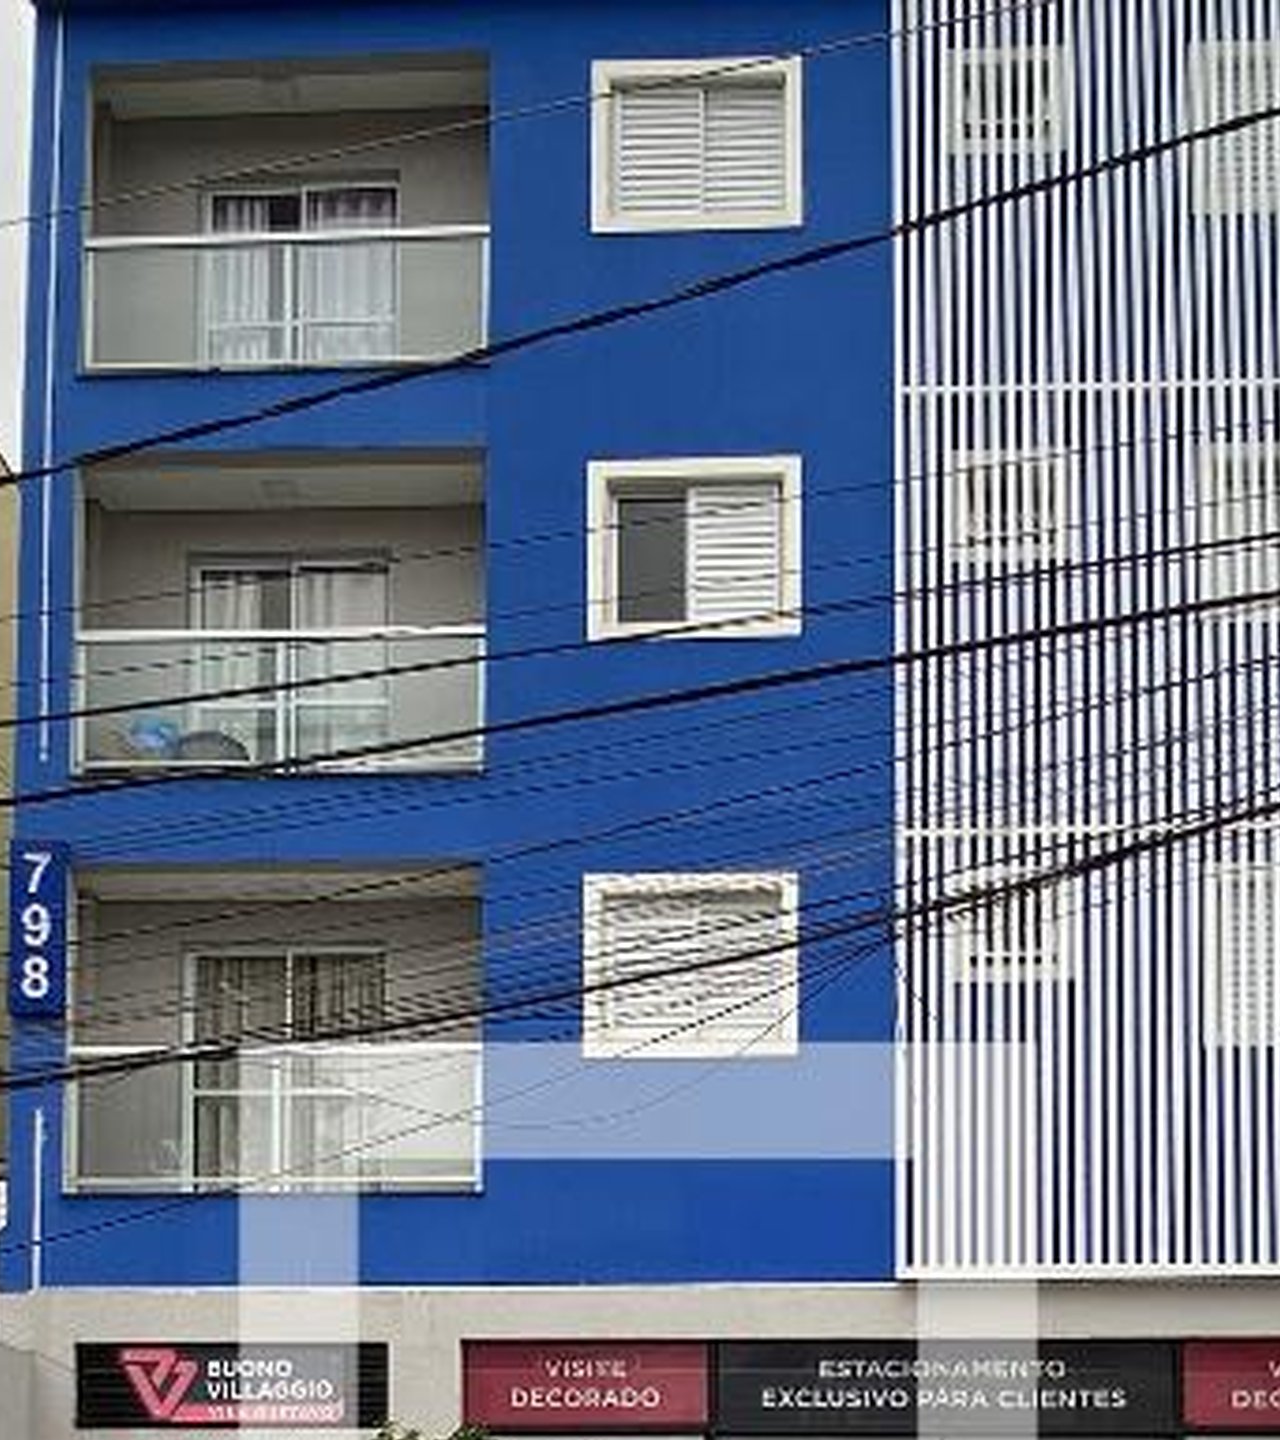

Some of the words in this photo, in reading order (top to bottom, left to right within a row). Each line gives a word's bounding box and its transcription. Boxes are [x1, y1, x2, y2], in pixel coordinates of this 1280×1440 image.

[22, 853, 51, 998] 798
[207, 1360, 293, 1377] BUONO
[545, 1359, 627, 1378] VISITE
[818, 1359, 1066, 1379] ESTACIONAMENTO
[207, 1379, 334, 1400] VILLAGGIO
[510, 1386, 661, 1408] DECORADO
[761, 1387, 909, 1408] EXCLUSIVO
[918, 1387, 989, 1408] PARA
[999, 1387, 1127, 1408] CLIENTES
